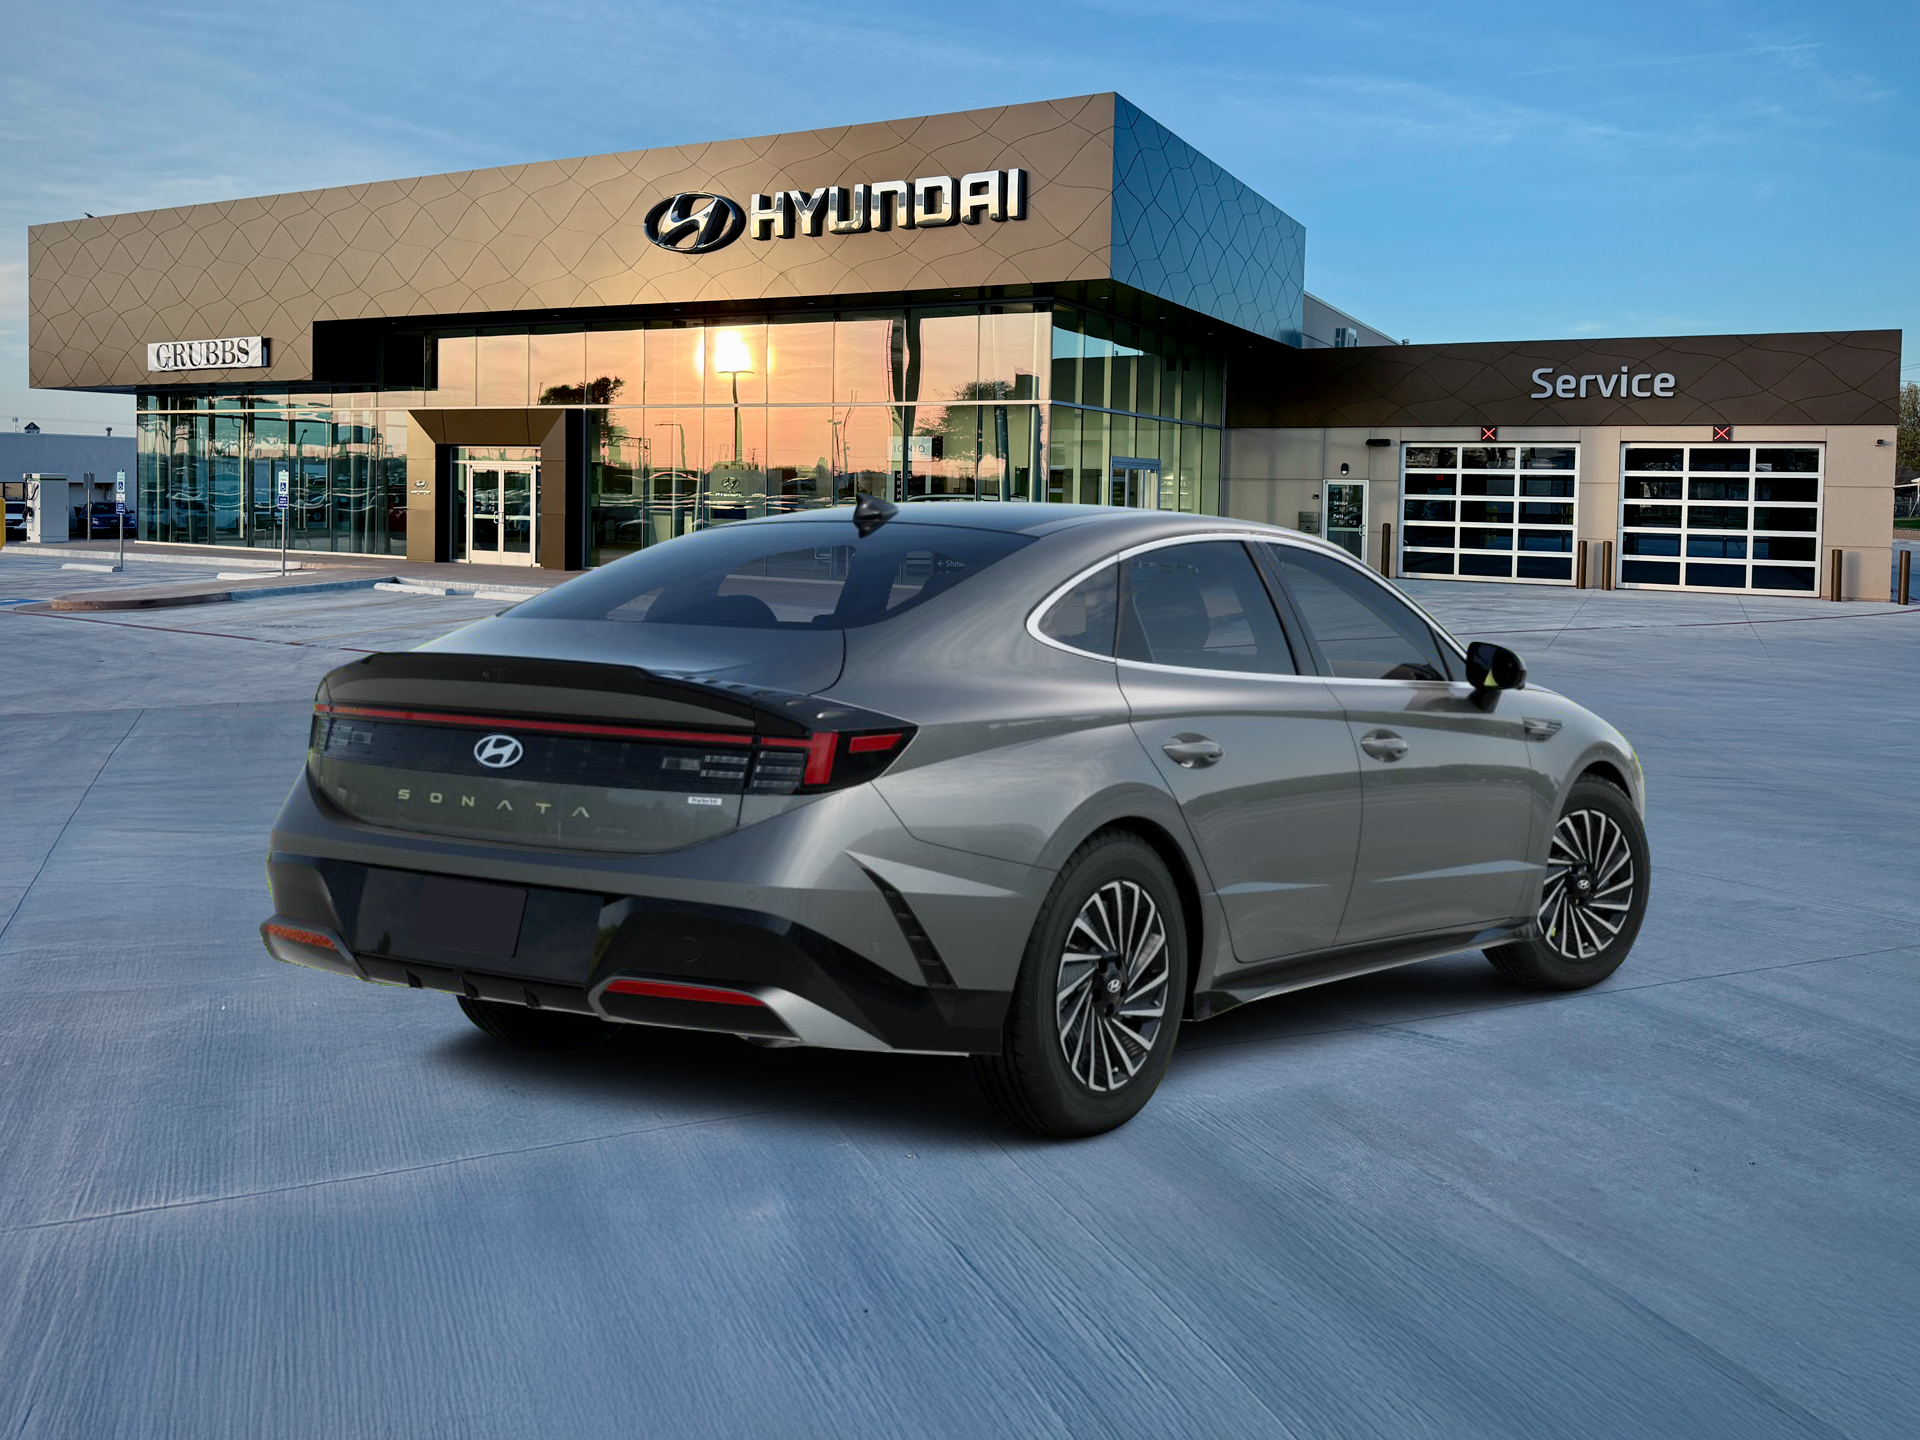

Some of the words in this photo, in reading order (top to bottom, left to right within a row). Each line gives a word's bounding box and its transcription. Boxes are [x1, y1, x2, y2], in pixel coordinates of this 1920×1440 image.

[750, 168, 1025, 240] HYUNDAI
[156, 338, 250, 369] GRUBBS
[1530, 365, 1676, 399] Service
[397, 788, 591, 819] SONATA
